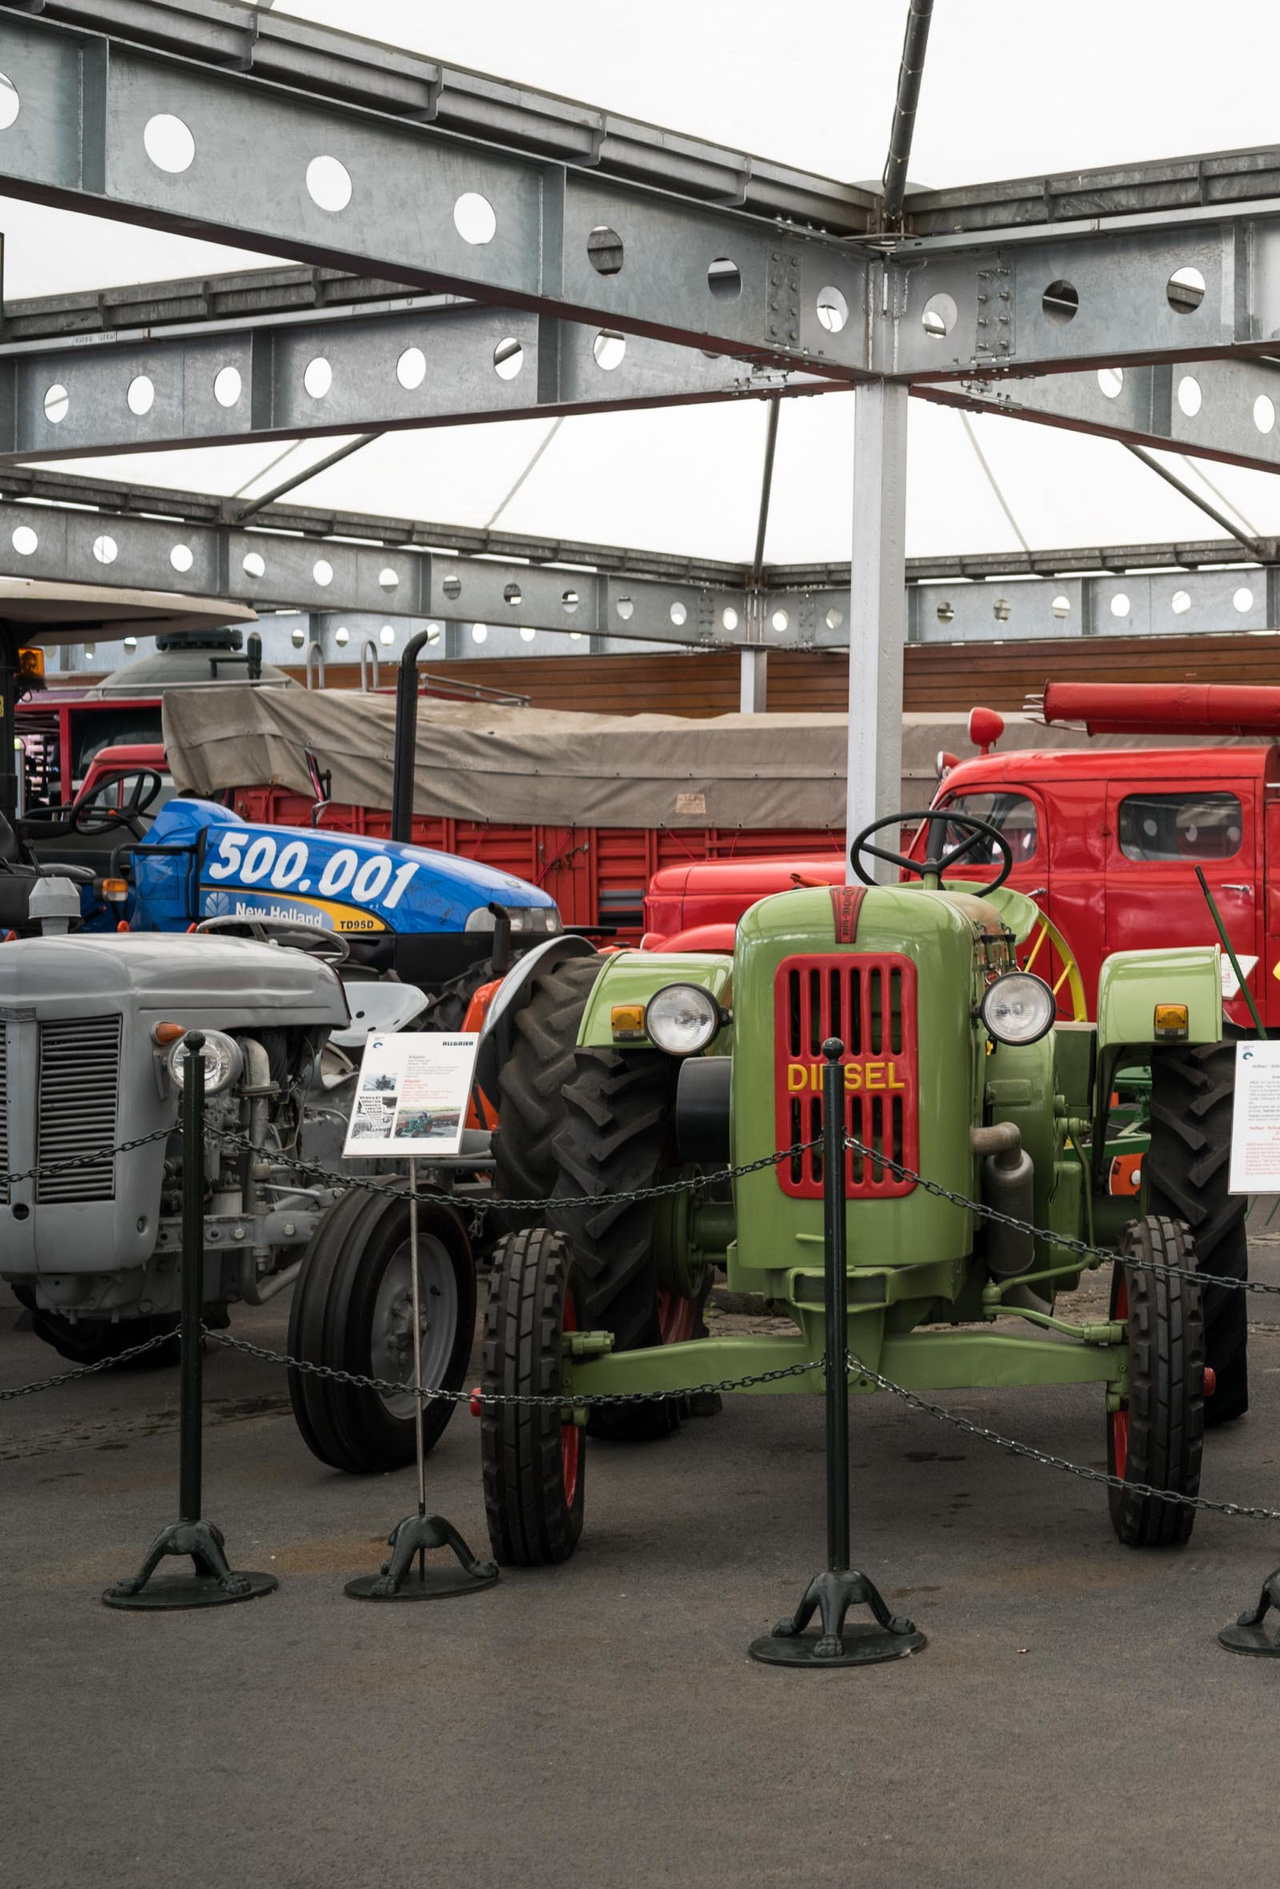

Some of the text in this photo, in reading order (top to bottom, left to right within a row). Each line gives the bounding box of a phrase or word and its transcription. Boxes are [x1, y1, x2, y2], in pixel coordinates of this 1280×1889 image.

[209, 832, 420, 909] 500.001
[235, 902, 323, 927] New Holland
[340, 920, 374, 930] TD95D
[787, 1062, 905, 1091] DISEL
